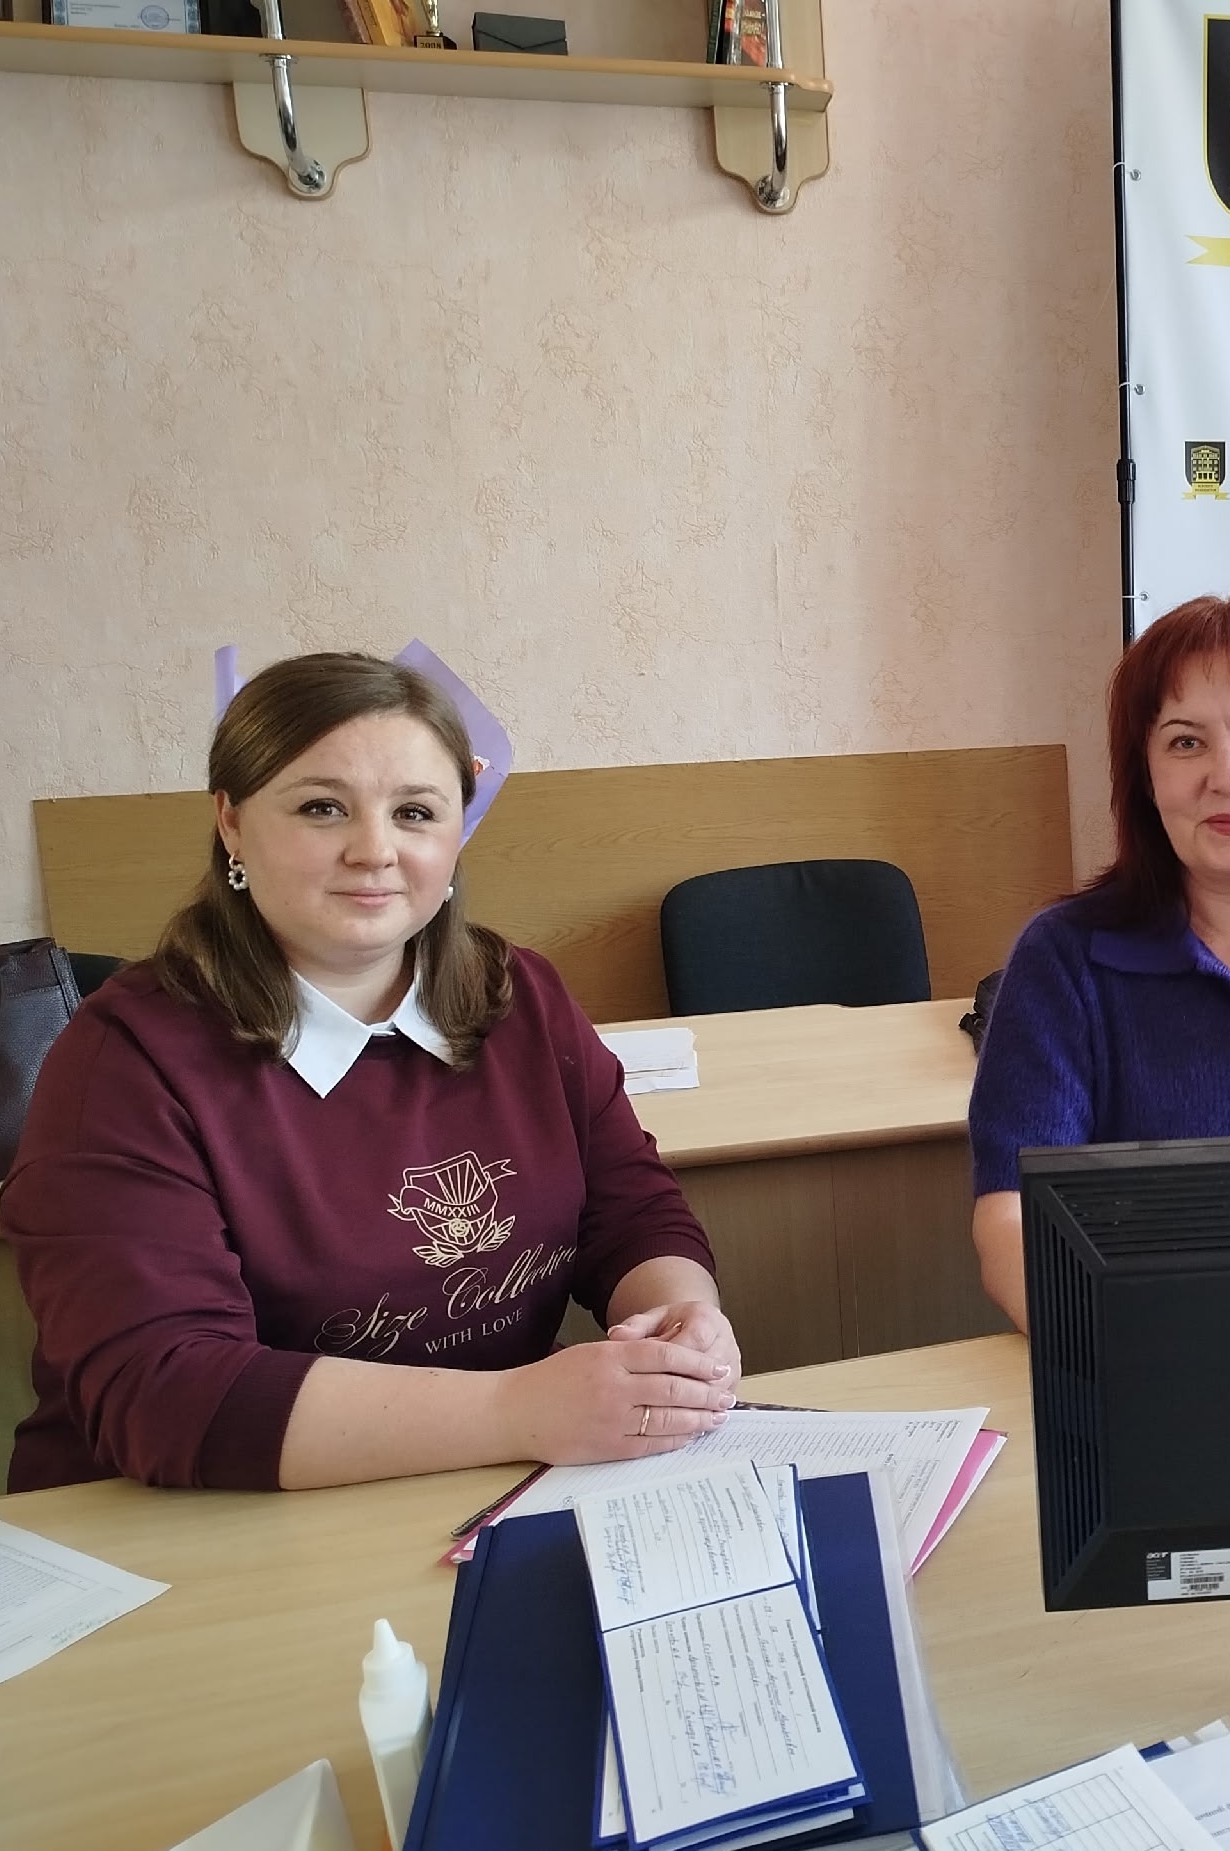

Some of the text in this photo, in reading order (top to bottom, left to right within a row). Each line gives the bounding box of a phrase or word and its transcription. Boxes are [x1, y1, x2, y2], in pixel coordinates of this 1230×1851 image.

[423, 1197, 481, 1218] MMXXIII
[314, 1292, 428, 1359] Size
[424, 1307, 524, 1355] WITH LOVE
